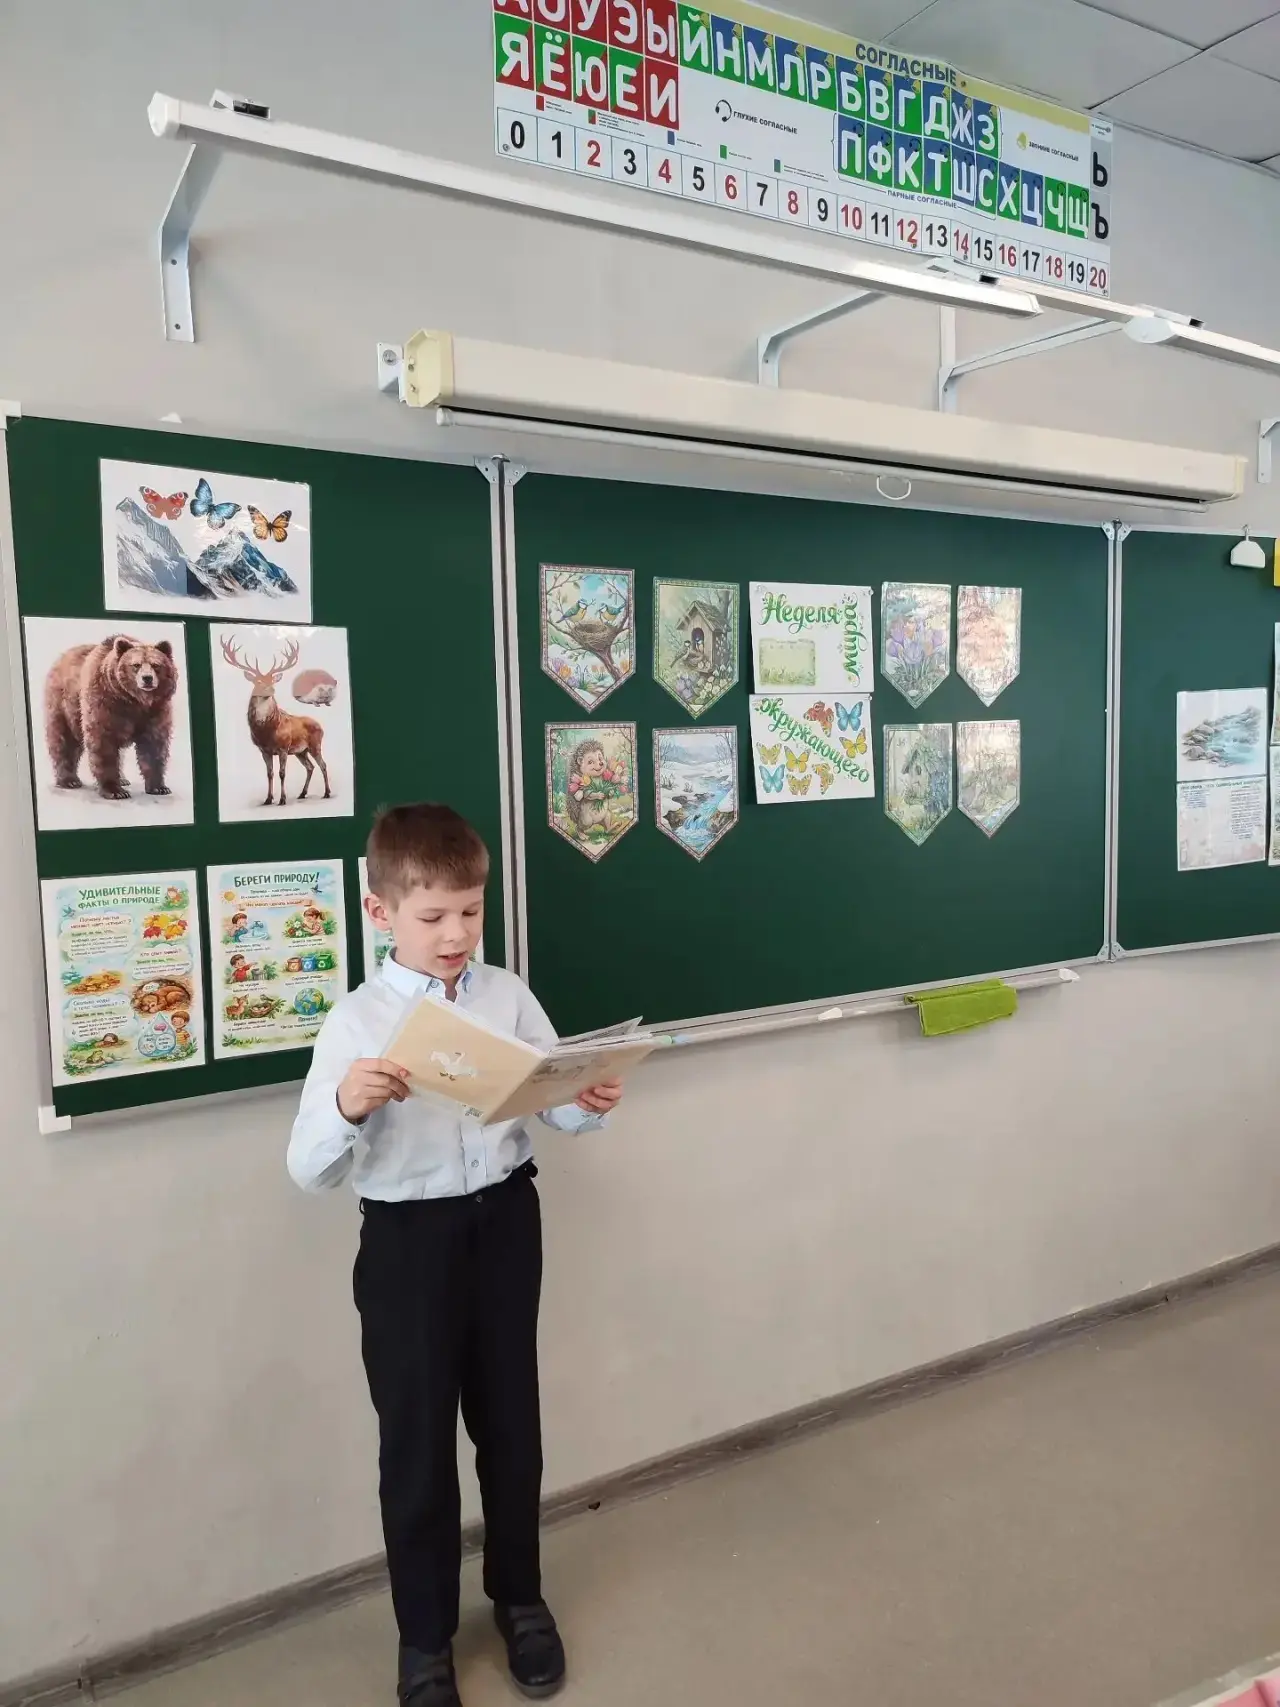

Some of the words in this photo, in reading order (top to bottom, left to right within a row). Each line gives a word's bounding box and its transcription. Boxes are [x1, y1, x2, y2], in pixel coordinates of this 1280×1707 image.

[501, 31, 529, 82] Я
[542, 31, 566, 92] Ё
[574, 52, 607, 102] Ю
[616, 64, 638, 112] Е
[650, 73, 676, 122] И
[614, 1, 638, 44] Э
[646, 8, 676, 57] Ы
[682, 11, 709, 67] Й
[715, 30, 741, 77] Н
[747, 41, 774, 86] М
[780, 53, 805, 96] Л
[810, 61, 831, 100] Р
[840, 72, 862, 112] Б
[869, 79, 890, 121] В
[898, 89, 916, 127] Г
[925, 96, 950, 140] Д
[951, 101, 973, 146] Ж
[978, 114, 995, 150] З
[855, 43, 957, 85] СОГЛАСНЫЕ
[733, 109, 758, 125] ГЛУХИЕ
[759, 118, 798, 134] СОГЛАСНЫЕ
[841, 129, 862, 173] П
[868, 141, 892, 180] Ф
[898, 147, 919, 188] К
[928, 151, 948, 191] Т
[953, 160, 976, 200] Ш
[978, 168, 993, 206] С
[999, 175, 1018, 215] Х
[1022, 183, 1042, 226] Ц
[1046, 189, 1064, 228] Ч
[1068, 194, 1089, 239] Щ
[1093, 151, 1108, 187] Ь
[511, 121, 525, 149] 0
[551, 131, 562, 158] 1
[587, 140, 601, 167] 2
[623, 149, 637, 175] 3
[658, 159, 671, 184] 4
[692, 166, 705, 191] 5
[724, 174, 737, 199] 6
[756, 183, 769, 206] 7
[787, 190, 799, 215] 8
[817, 198, 829, 222] 9
[841, 204, 862, 230] 10
[871, 212, 889, 237] 11
[897, 218, 918, 244] 12
[925, 223, 948, 247] 13
[954, 229, 970, 255] 14
[974, 236, 993, 261] 15
[999, 242, 1016, 267] 16
[1022, 250, 1040, 272] 17
[1046, 255, 1063, 278] 18
[1068, 262, 1085, 283] 19
[1090, 266, 1107, 289] 20
[887, 190, 915, 203] ПАРНЫЕ
[917, 195, 957, 209] СОГЛАСНЫЕ
[1091, 202, 1109, 239] Ъ
[757, 591, 840, 634] Неделя
[842, 592, 867, 687] мира
[78, 886, 161, 901] УДИВИТЕЛЬНЫЕ
[234, 875, 271, 888] БЕРЕГИ
[274, 872, 320, 884] ПРИРОДУ!
[78, 899, 110, 910] ФАКТЫ
[121, 896, 160, 905] ПРИРОДЕ
